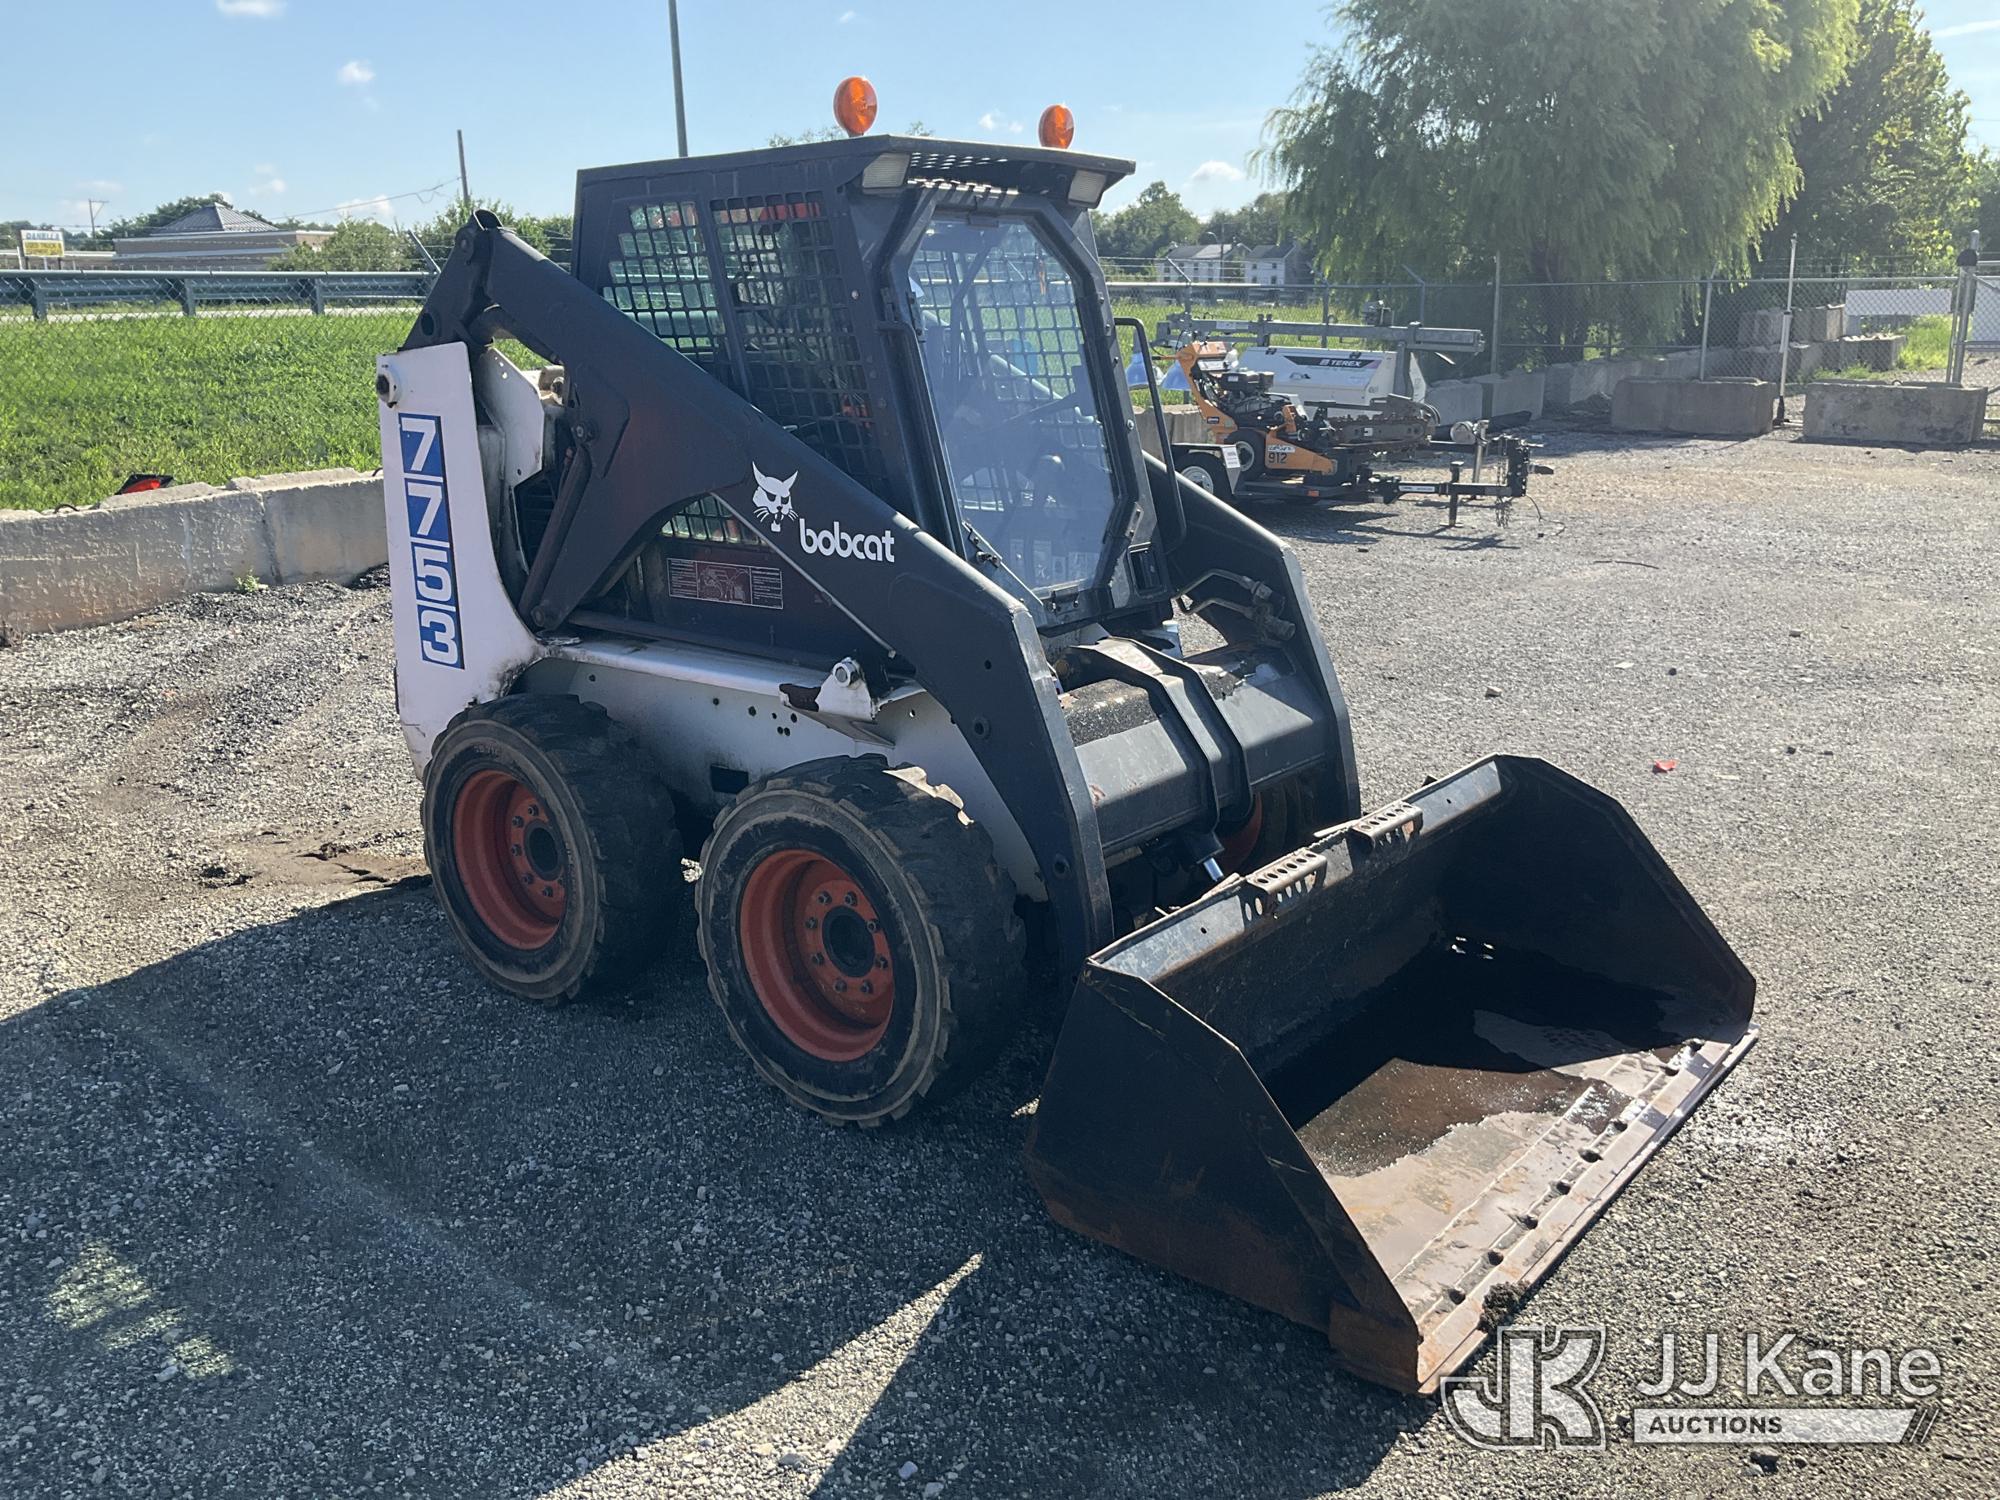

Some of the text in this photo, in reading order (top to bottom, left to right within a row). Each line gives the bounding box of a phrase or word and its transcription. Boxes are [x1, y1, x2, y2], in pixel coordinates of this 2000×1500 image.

[1268, 452, 1288, 464] 912
[401, 417, 458, 665] 7753
[799, 518, 895, 563] bobcat
